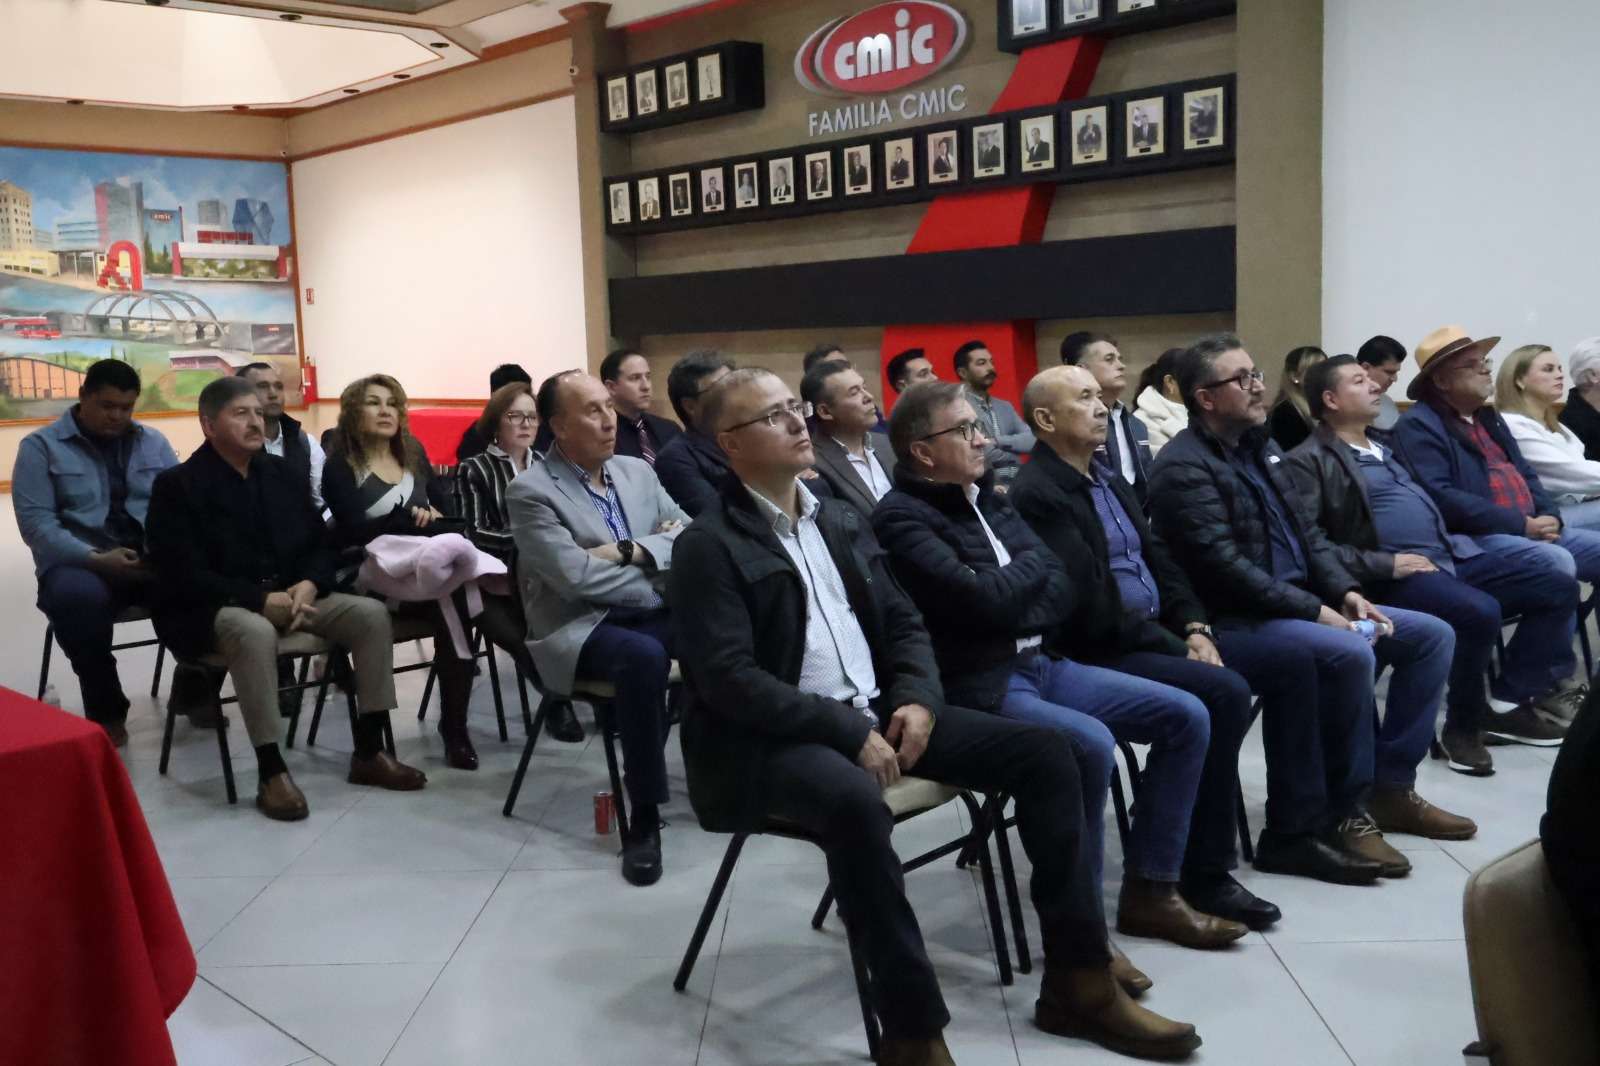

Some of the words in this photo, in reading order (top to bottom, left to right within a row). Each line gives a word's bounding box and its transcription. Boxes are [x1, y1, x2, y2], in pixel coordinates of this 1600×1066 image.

[834, 8, 933, 80] cmic
[808, 99, 893, 137] FAMILIA
[900, 84, 966, 120] CMIC
